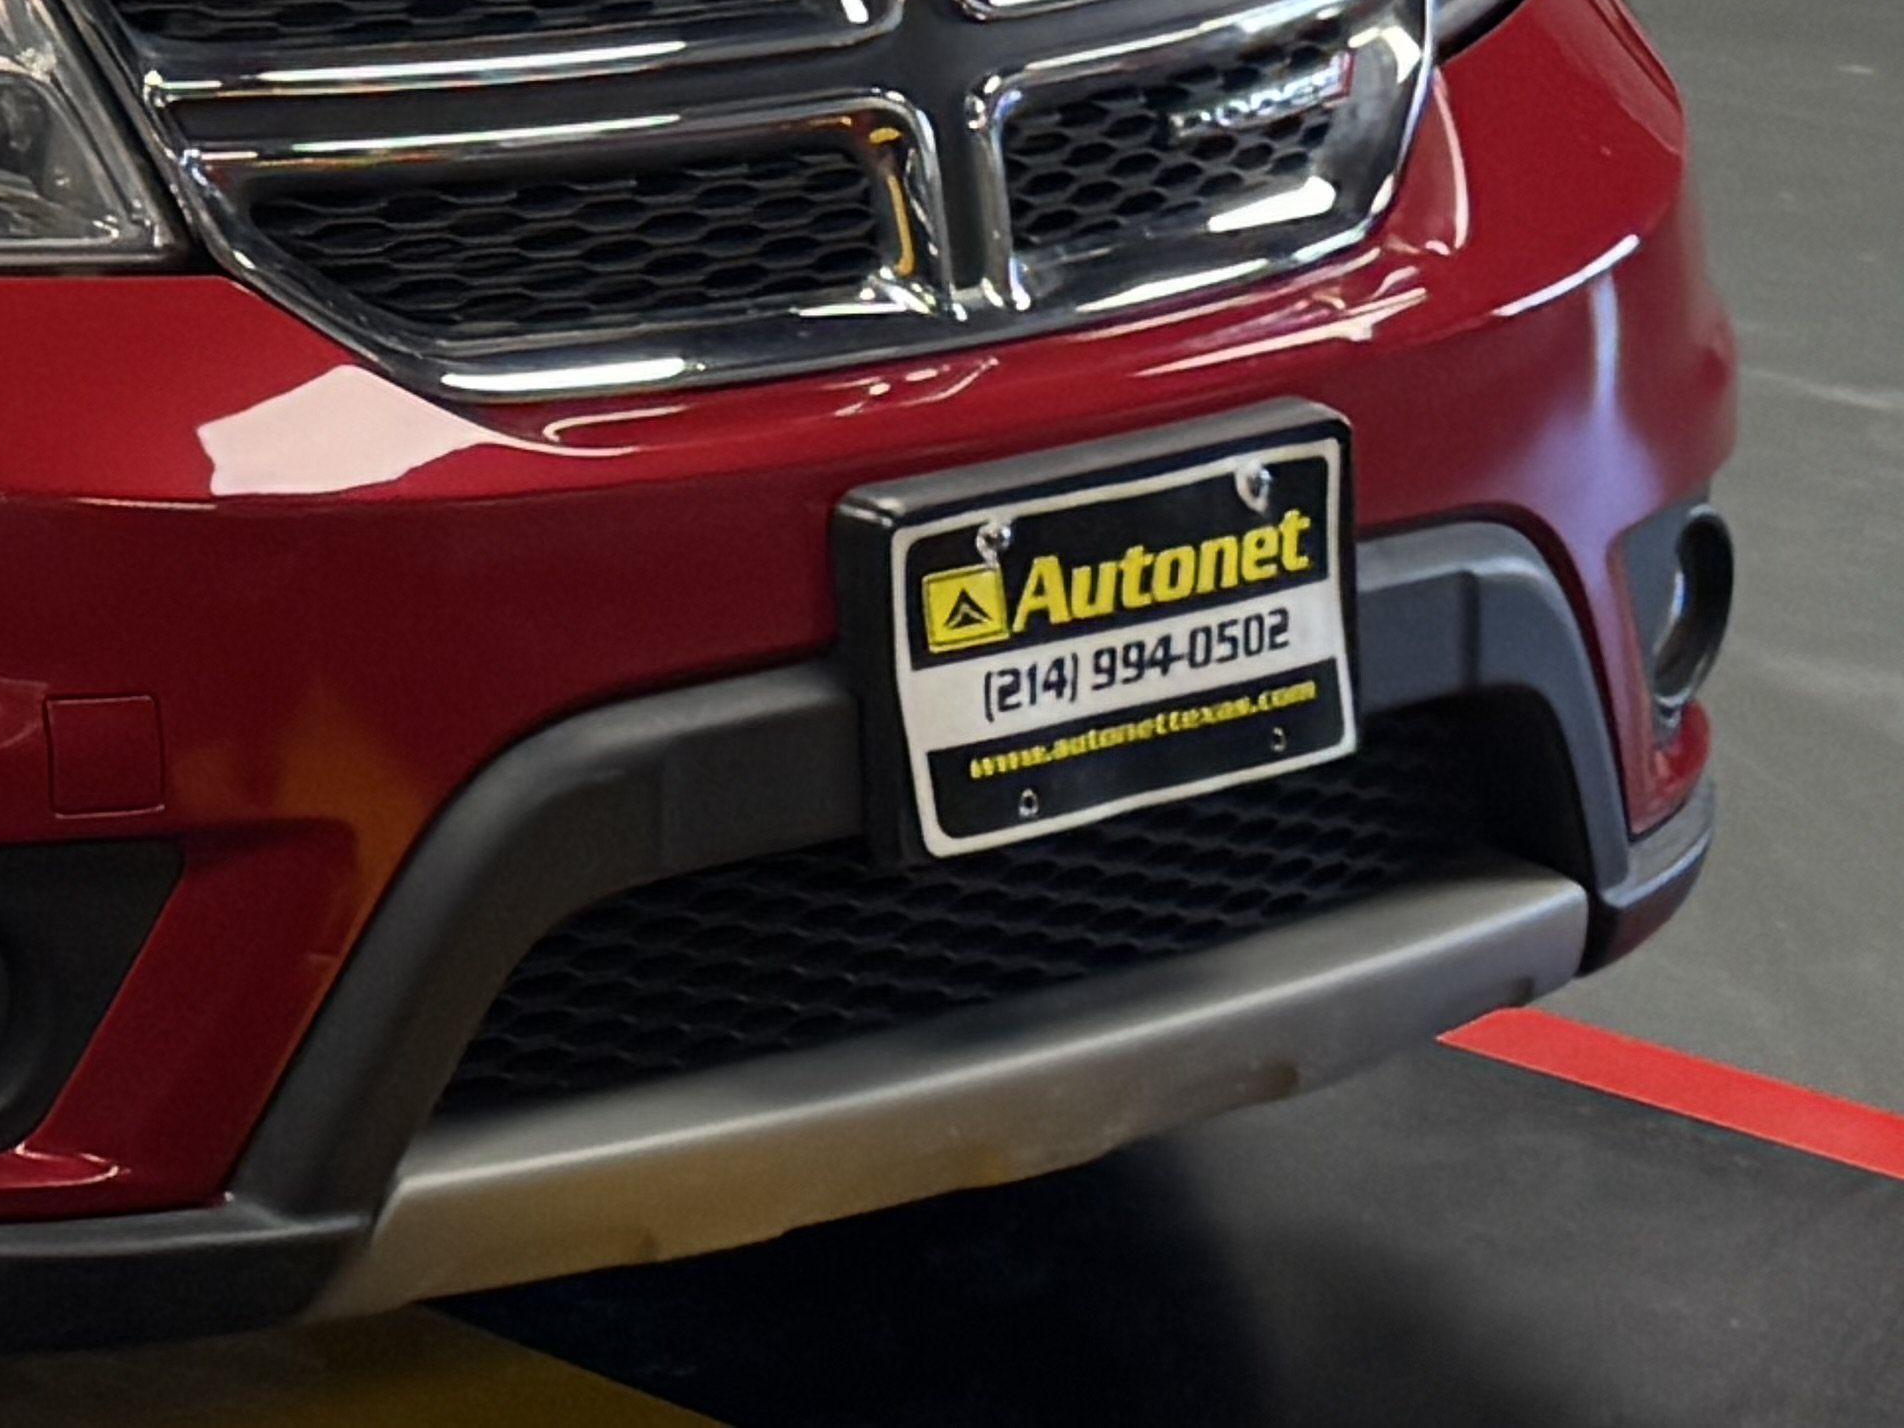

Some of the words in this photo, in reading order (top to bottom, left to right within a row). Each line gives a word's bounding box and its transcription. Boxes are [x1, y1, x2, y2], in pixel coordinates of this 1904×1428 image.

[1012, 509, 1312, 633] Autonet
[984, 651, 1079, 723] (214)
[1092, 608, 1290, 691] 994-0502
[970, 680, 1316, 779] www.autonettexas.com
